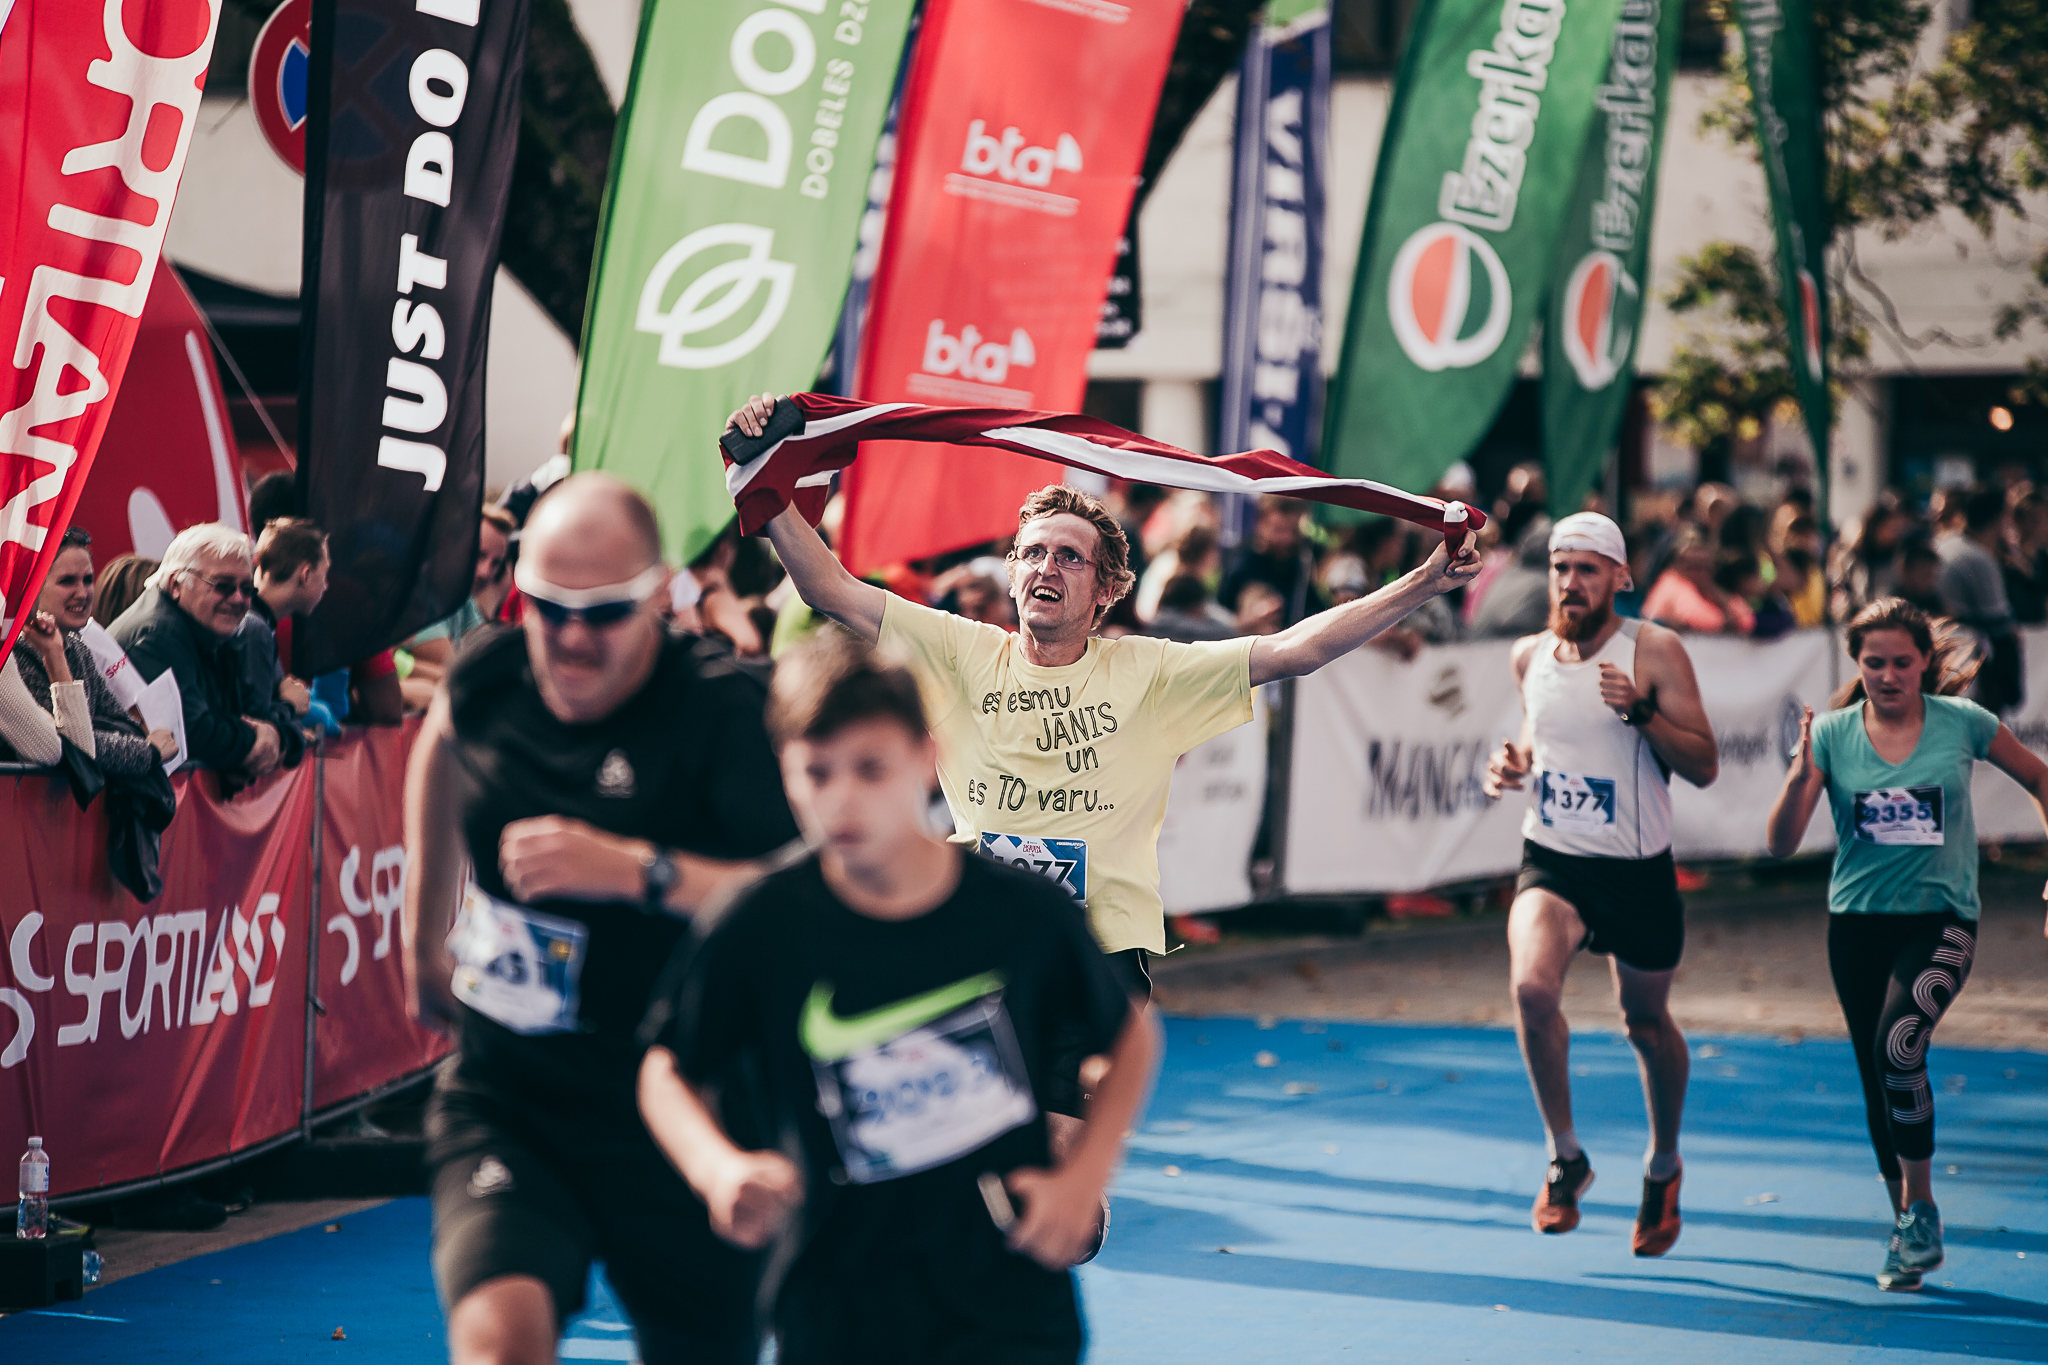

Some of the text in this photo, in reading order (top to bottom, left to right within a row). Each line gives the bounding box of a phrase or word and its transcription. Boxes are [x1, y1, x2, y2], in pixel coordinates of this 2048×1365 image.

[403, 48, 469, 207] DO
[681, 0, 827, 190] DO
[800, 58, 854, 199] DOBELES
[961, 119, 1055, 187] bta
[377, 233, 448, 491] JUST
[922, 319, 1010, 384] bta
[1007, 686, 1071, 713] esmu
[1036, 702, 1118, 752] JĀNIS
[1066, 746, 1099, 773] un
[968, 779, 987, 805] es
[998, 775, 1027, 811] TO
[1551, 788, 1608, 811] 1377
[1863, 803, 1932, 824] 2355
[371, 845, 413, 960] SP
[57, 893, 286, 1047] SPORTLAND
